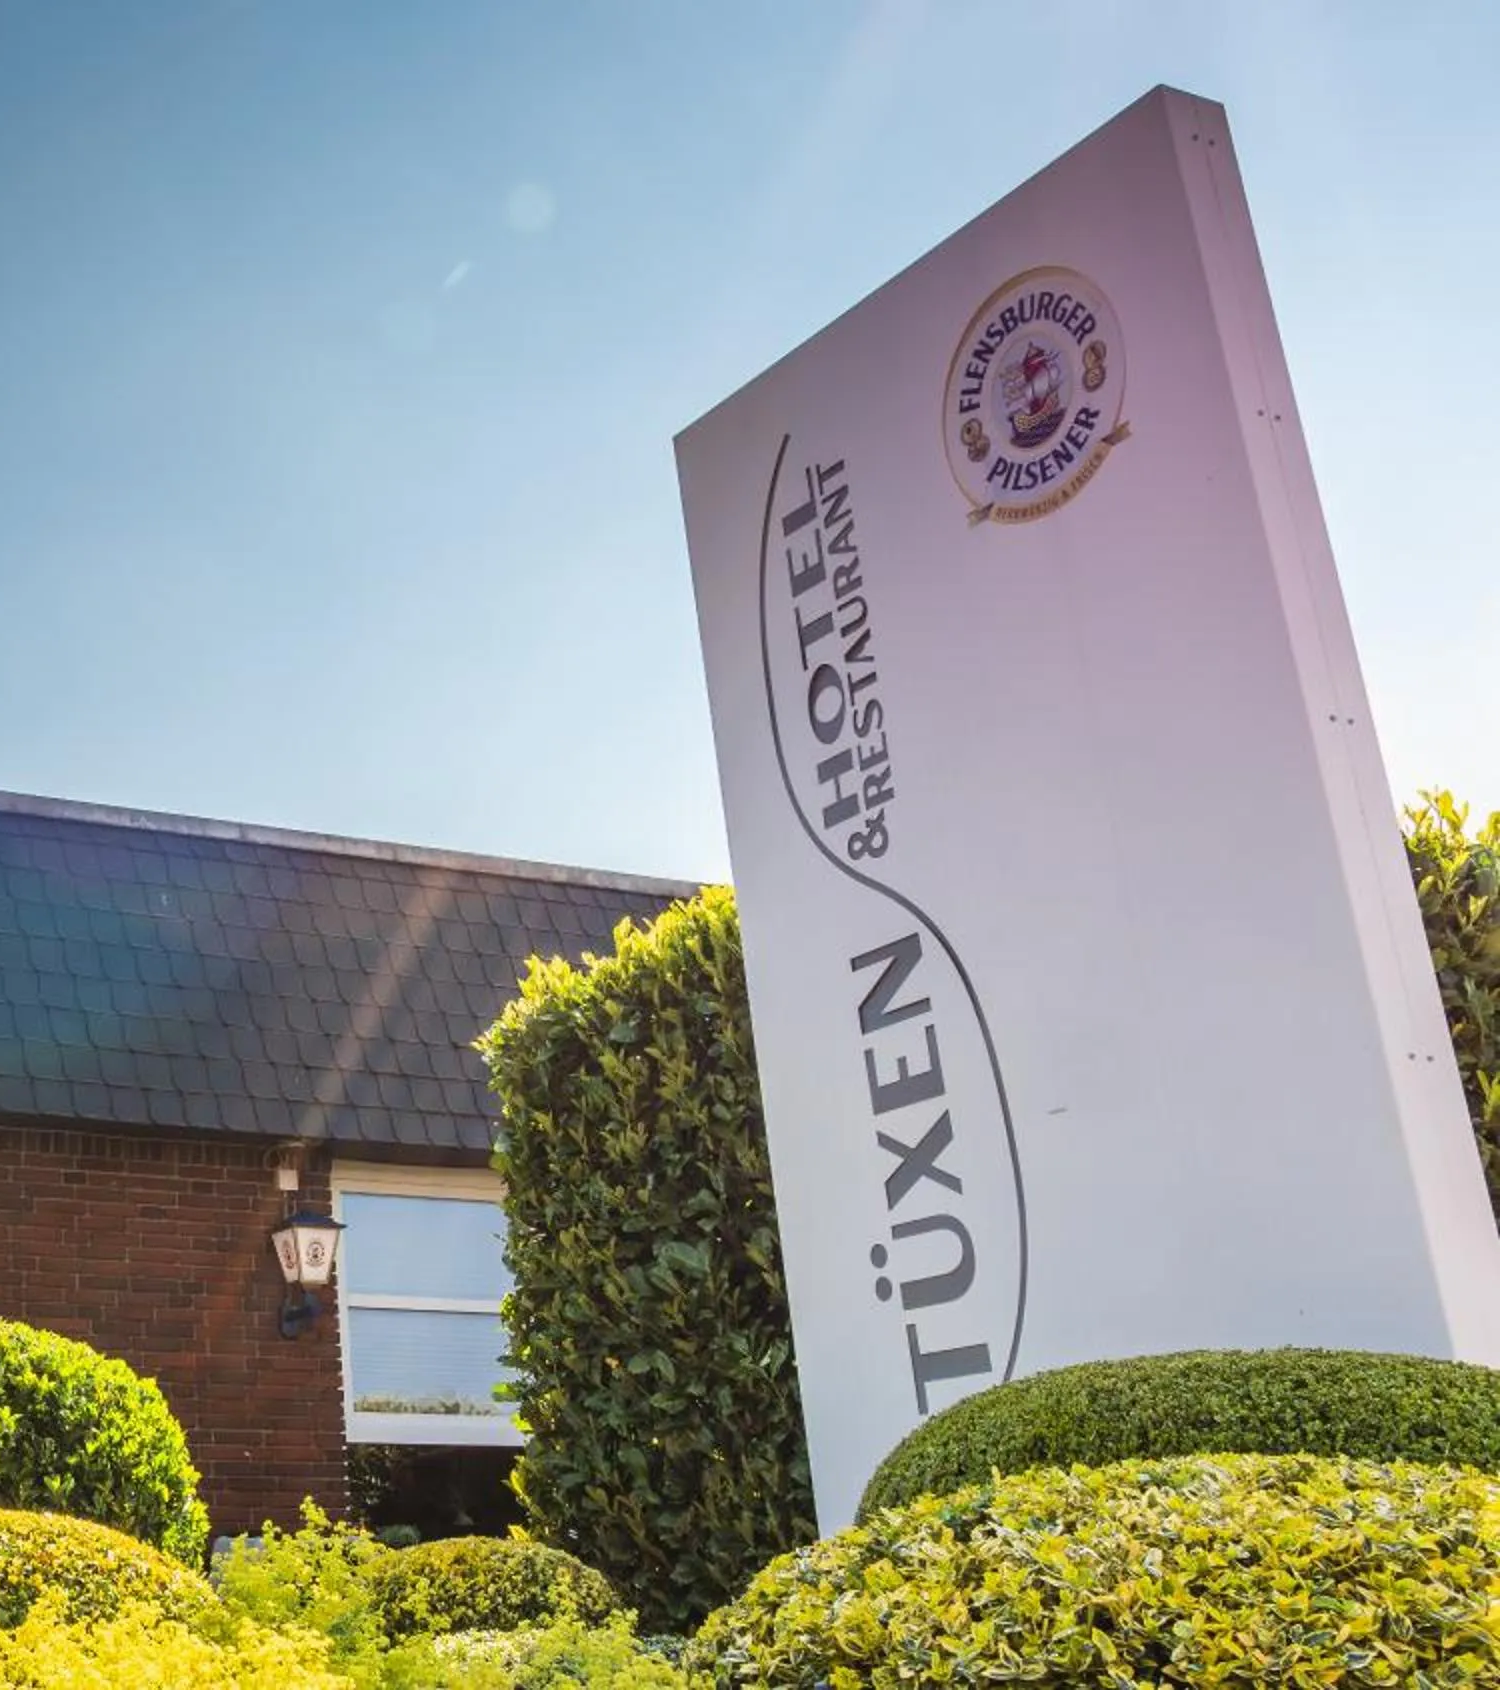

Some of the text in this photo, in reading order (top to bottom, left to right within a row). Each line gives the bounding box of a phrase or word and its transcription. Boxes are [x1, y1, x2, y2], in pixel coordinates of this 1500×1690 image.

[959, 291, 1097, 414] FLENSBURGER
[986, 402, 1101, 491] PILSENER
[781, 466, 861, 830] HOTEL
[850, 932, 993, 1416] TÜXEN
